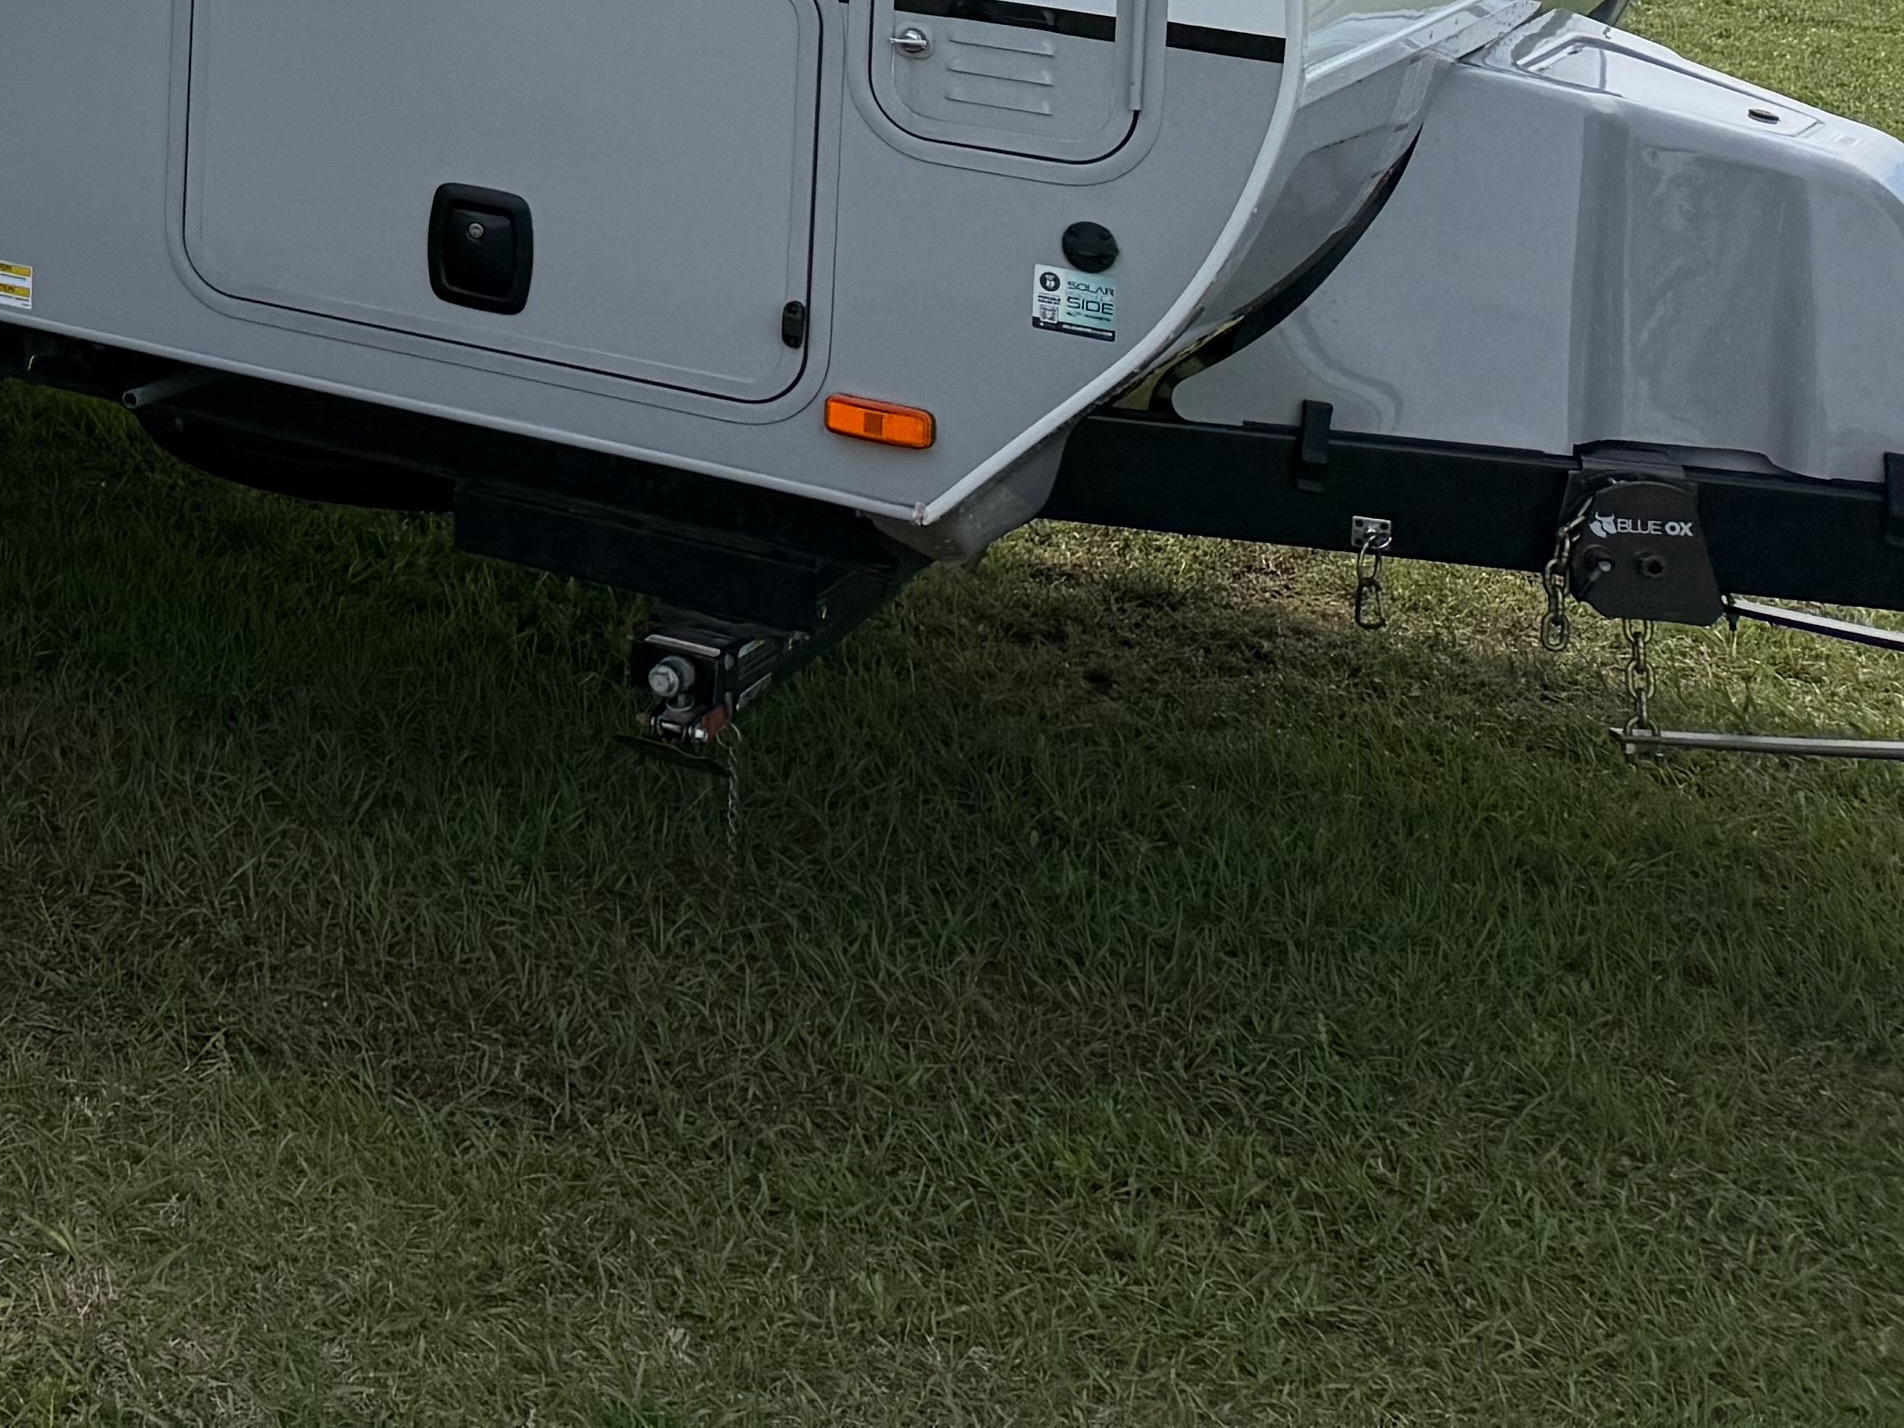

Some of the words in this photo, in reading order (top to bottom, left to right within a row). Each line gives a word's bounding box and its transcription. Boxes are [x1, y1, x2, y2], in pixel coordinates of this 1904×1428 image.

[1067, 281, 1114, 296] SOLAR
[1067, 296, 1114, 315] SIDE
[1617, 518, 1663, 535] BLUE
[1664, 521, 1694, 537] OX
